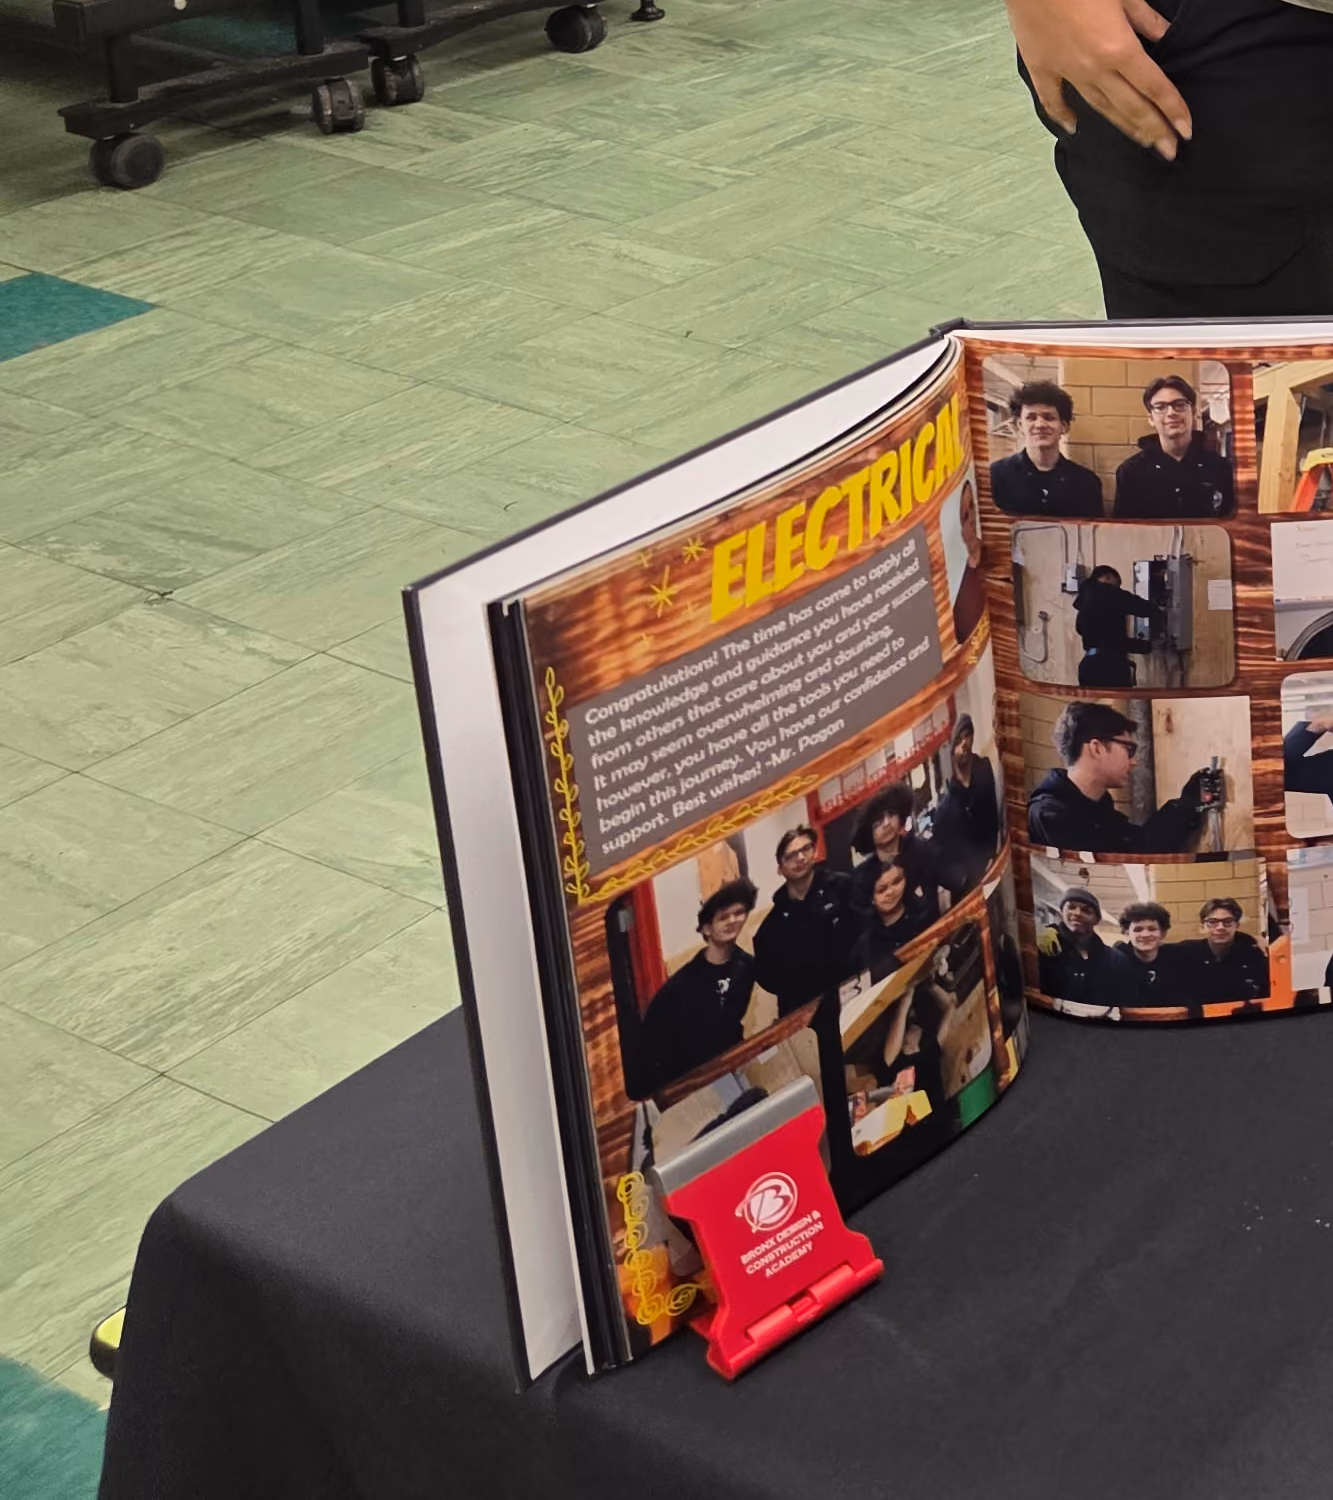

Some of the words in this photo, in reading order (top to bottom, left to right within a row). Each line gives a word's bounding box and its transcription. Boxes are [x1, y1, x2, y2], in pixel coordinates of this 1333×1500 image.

[585, 650, 719, 725] Congratulations!
[721, 638, 750, 661] The
[753, 620, 786, 645] time
[788, 606, 813, 626] has
[815, 584, 851, 611] come
[853, 575, 867, 591] to
[869, 552, 902, 580] apply
[902, 537, 916, 558] all
[587, 726, 617, 748] the
[620, 679, 710, 733] knowledge
[712, 662, 743, 687] and
[746, 628, 812, 672] guidance
[813, 612, 840, 637] you
[841, 592, 873, 620] have
[875, 556, 920, 599] received
[591, 740, 632, 770] from
[635, 715, 686, 747] others
[687, 696, 722, 723] that
[725, 679, 758, 703] care
[760, 653, 805, 685] about
[807, 639, 833, 663] you
[835, 618, 861, 644] and
[862, 602, 890, 630] your
[594, 772, 608, 791] It
[611, 755, 649, 782] may
[652, 734, 694, 763] seem
[696, 677, 802, 739] overwhelming
[804, 657, 832, 684] and
[597, 768, 672, 813] however,
[674, 749, 705, 776] you
[708, 729, 748, 756] have
[750, 713, 770, 735] all
[772, 702, 798, 723] the
[800, 682, 832, 709] tools
[833, 667, 859, 692] you
[860, 643, 892, 673] need
[892, 636, 905, 653] to
[598, 801, 647, 835] begin
[649, 785, 678, 810] this
[745, 735, 778, 758] You
[779, 714, 816, 742] have
[818, 698, 843, 719] our
[843, 655, 908, 704] confidence
[908, 635, 930, 662] and
[601, 810, 671, 855] support.
[672, 792, 708, 819] Best
[709, 761, 763, 799] wishes!
[798, 718, 846, 752] Pagan
[740, 1237, 776, 1264] BRONX
[745, 1220, 825, 1274] CONSTRUCTION
[765, 1241, 813, 1277] ACADEMY
